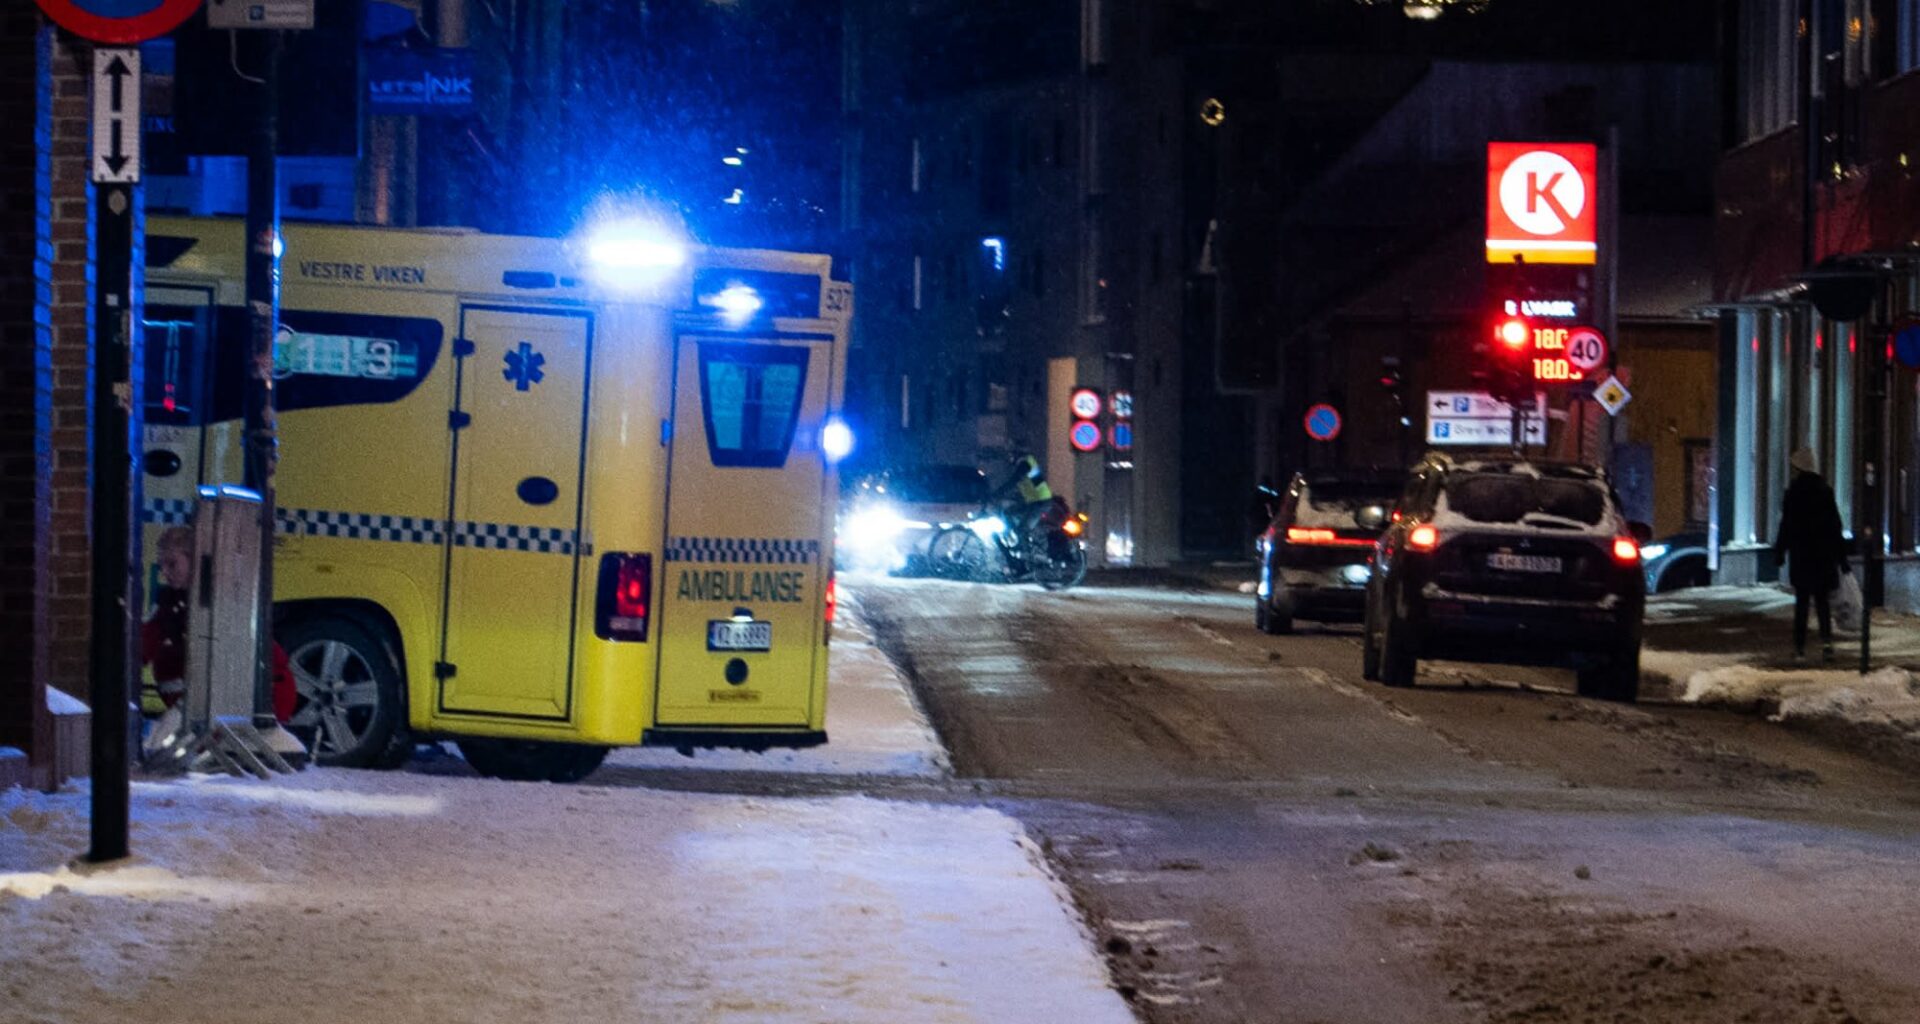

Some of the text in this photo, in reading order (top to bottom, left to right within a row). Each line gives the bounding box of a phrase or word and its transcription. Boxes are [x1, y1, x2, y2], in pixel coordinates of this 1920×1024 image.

[1526, 171, 1572, 222] K
[300, 261, 425, 283] VESTRE VIKEN
[827, 287, 850, 311] 527
[1571, 338, 1599, 361] 40
[1076, 397, 1096, 411] 40
[677, 569, 804, 602] AMBULANSE
